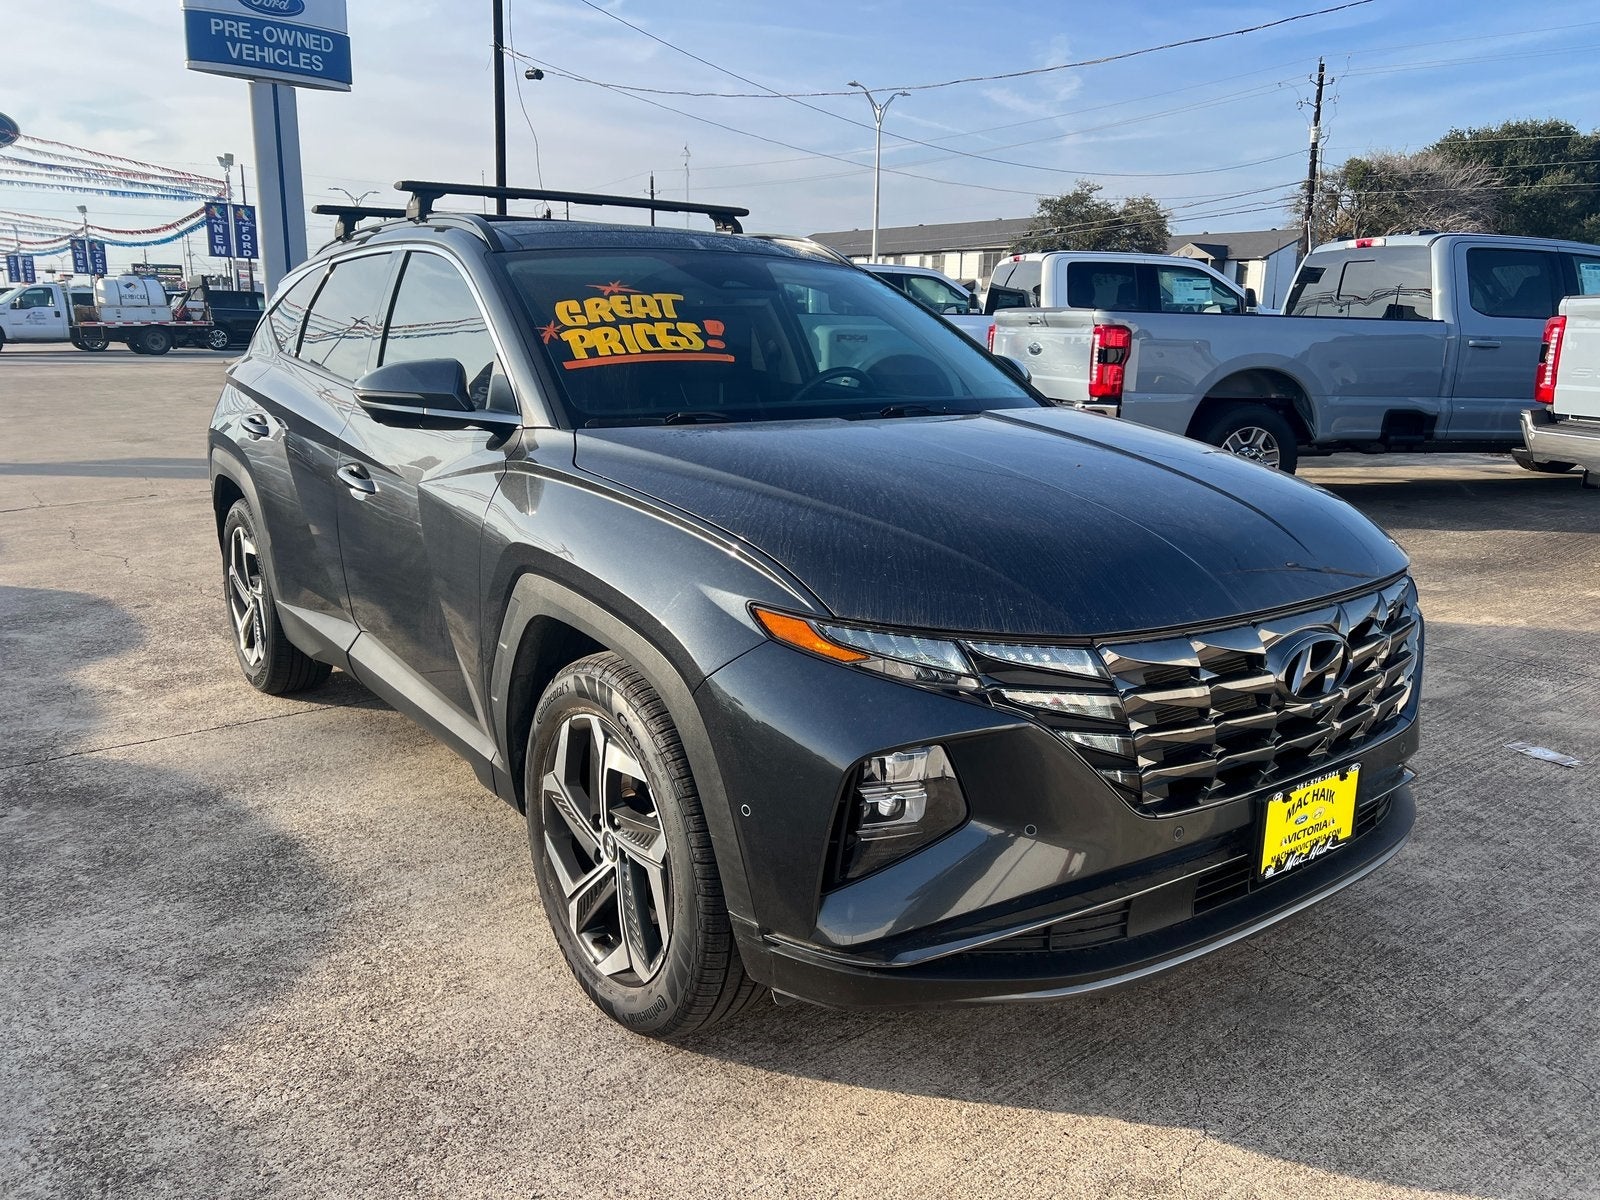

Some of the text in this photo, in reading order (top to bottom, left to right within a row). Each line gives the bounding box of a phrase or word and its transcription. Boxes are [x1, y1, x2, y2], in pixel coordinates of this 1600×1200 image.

[209, 17, 334, 54] PRE-OWNED
[226, 41, 324, 72] VEHICLES
[213, 224, 226, 255] NEW
[241, 226, 252, 257] FORD
[76, 252, 86, 273] NEW
[95, 253, 104, 273] FORD
[555, 293, 683, 327] GREAT
[560, 320, 726, 359] PRICES!
[536, 682, 566, 724] Continental
[1285, 791, 1311, 823] MAC
[1311, 787, 1336, 805] HAIK
[1286, 822, 1328, 844] VICTORIA
[1283, 836, 1346, 872] Mac Haik
[627, 994, 668, 1025] Continental
